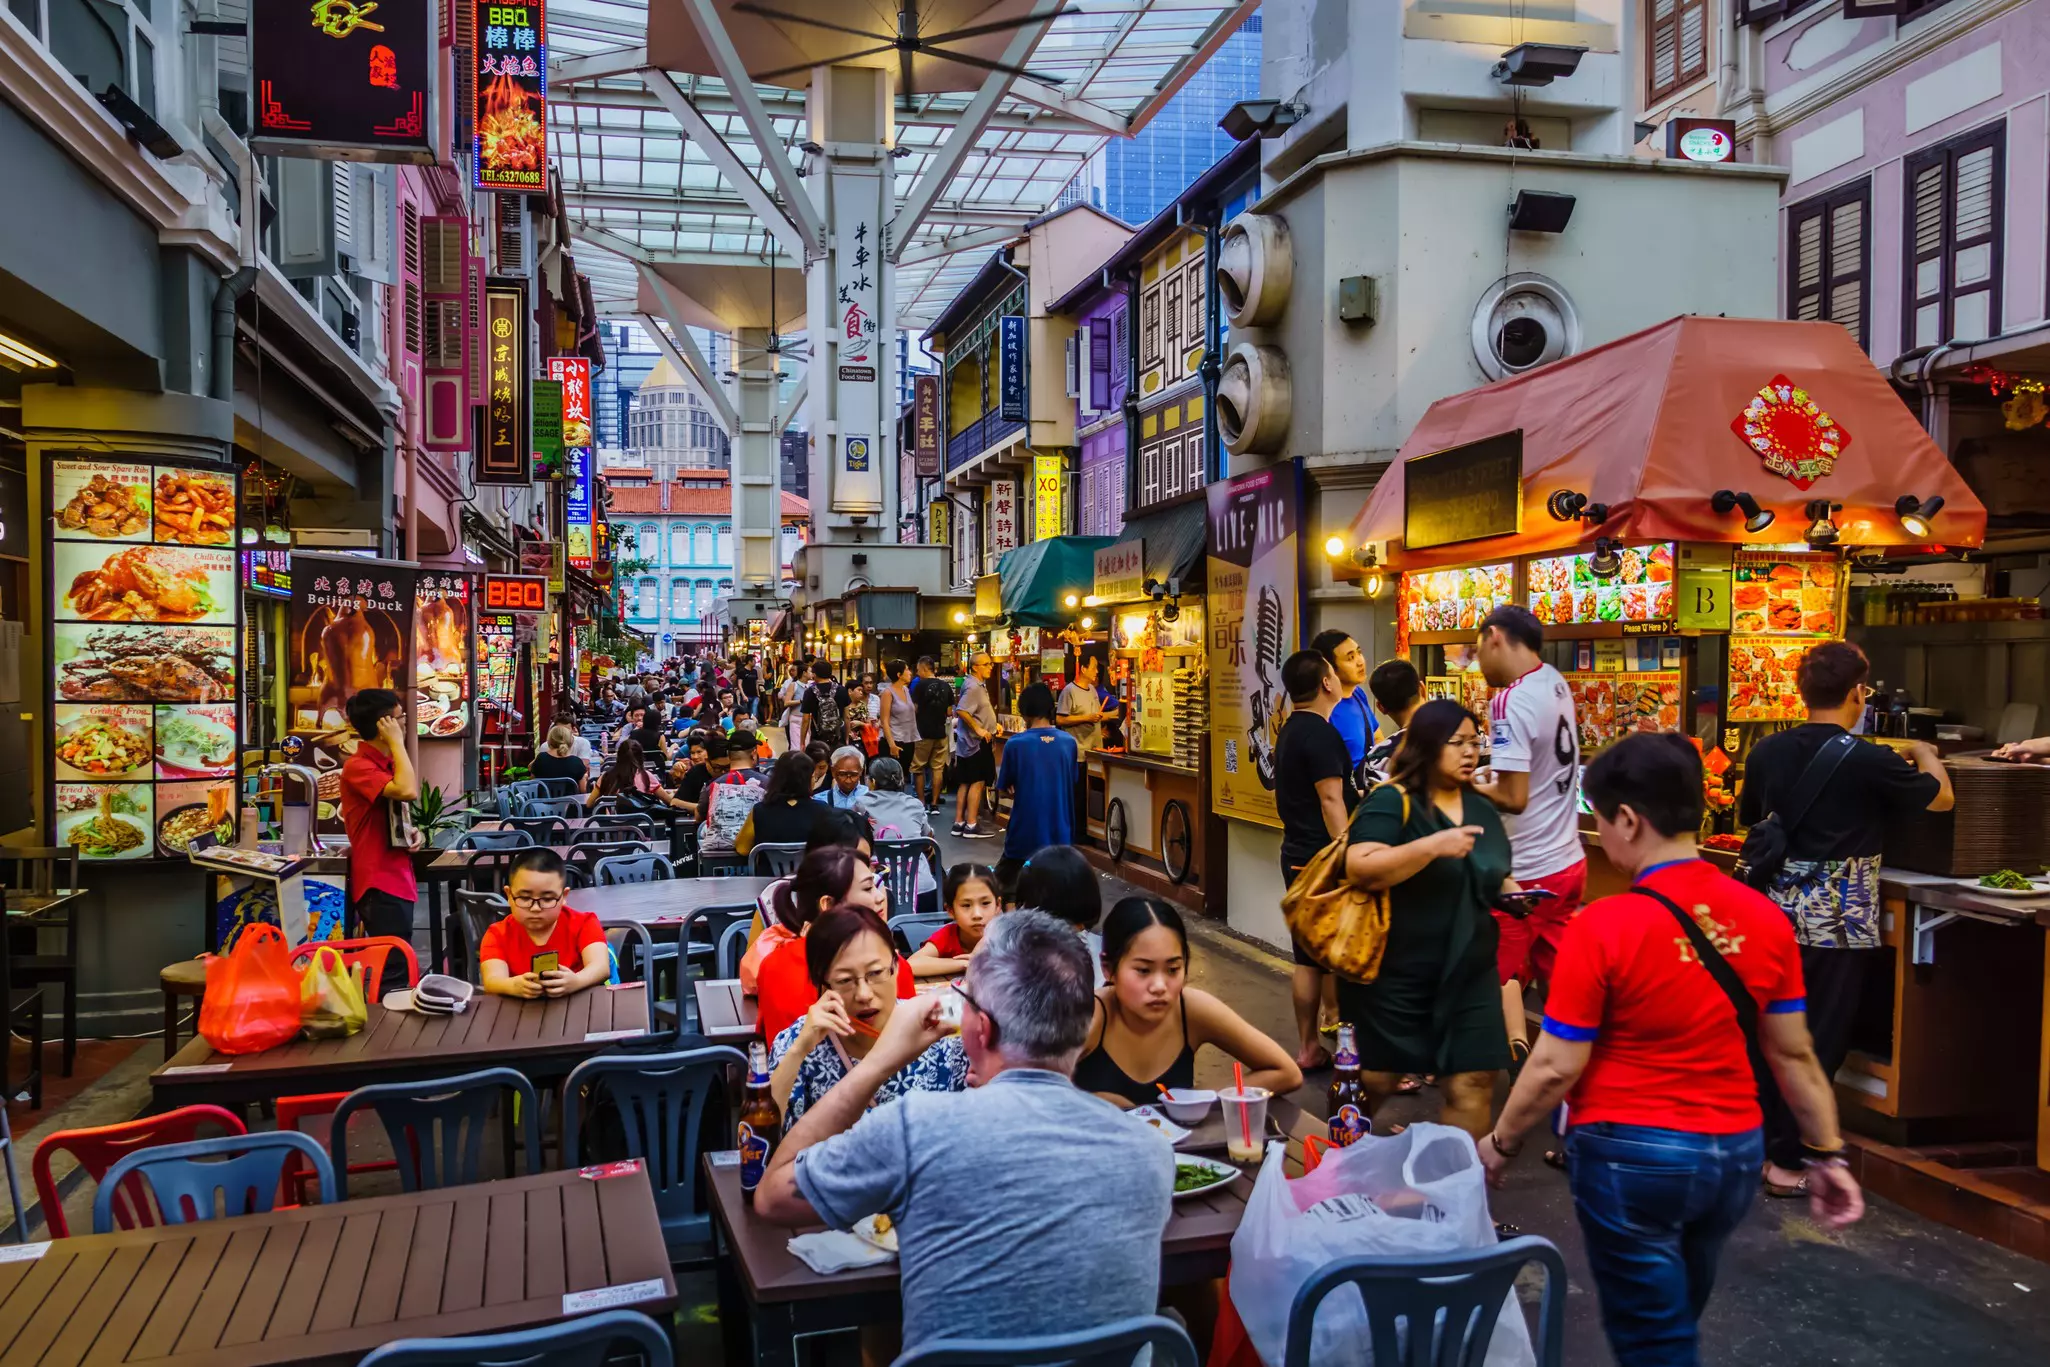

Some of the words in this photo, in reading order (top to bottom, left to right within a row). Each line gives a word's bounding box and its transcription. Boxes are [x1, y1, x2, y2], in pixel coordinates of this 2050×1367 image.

[489, 8, 529, 26] BBQ
[485, 27, 536, 50] 棒棒
[480, 169, 540, 184] TEL:63270688
[56, 463, 77, 471] Sweet
[78, 463, 92, 471] and
[93, 464, 110, 472] Sour
[112, 464, 131, 473] Spare
[133, 465, 149, 473] Ribs
[848, 460, 867, 470] Tiger
[1039, 478, 1058, 491] XO
[1216, 509, 1246, 552] LIVE
[1257, 498, 1284, 545] MIC
[216, 553, 232, 562] Crab
[416, 576, 464, 590] 京烤鸭
[416, 588, 443, 599] ijing
[447, 589, 467, 598] Duck
[487, 581, 544, 607] BBQ
[1695, 587, 1715, 614] B
[307, 593, 361, 611] Beijing
[367, 599, 403, 612] Duck
[216, 629, 232, 637] Crab
[1624, 624, 1641, 632] Please
[1648, 623, 1661, 632] Here
[59, 786, 83, 794] Fried
[742, 1145, 763, 1165] ger
